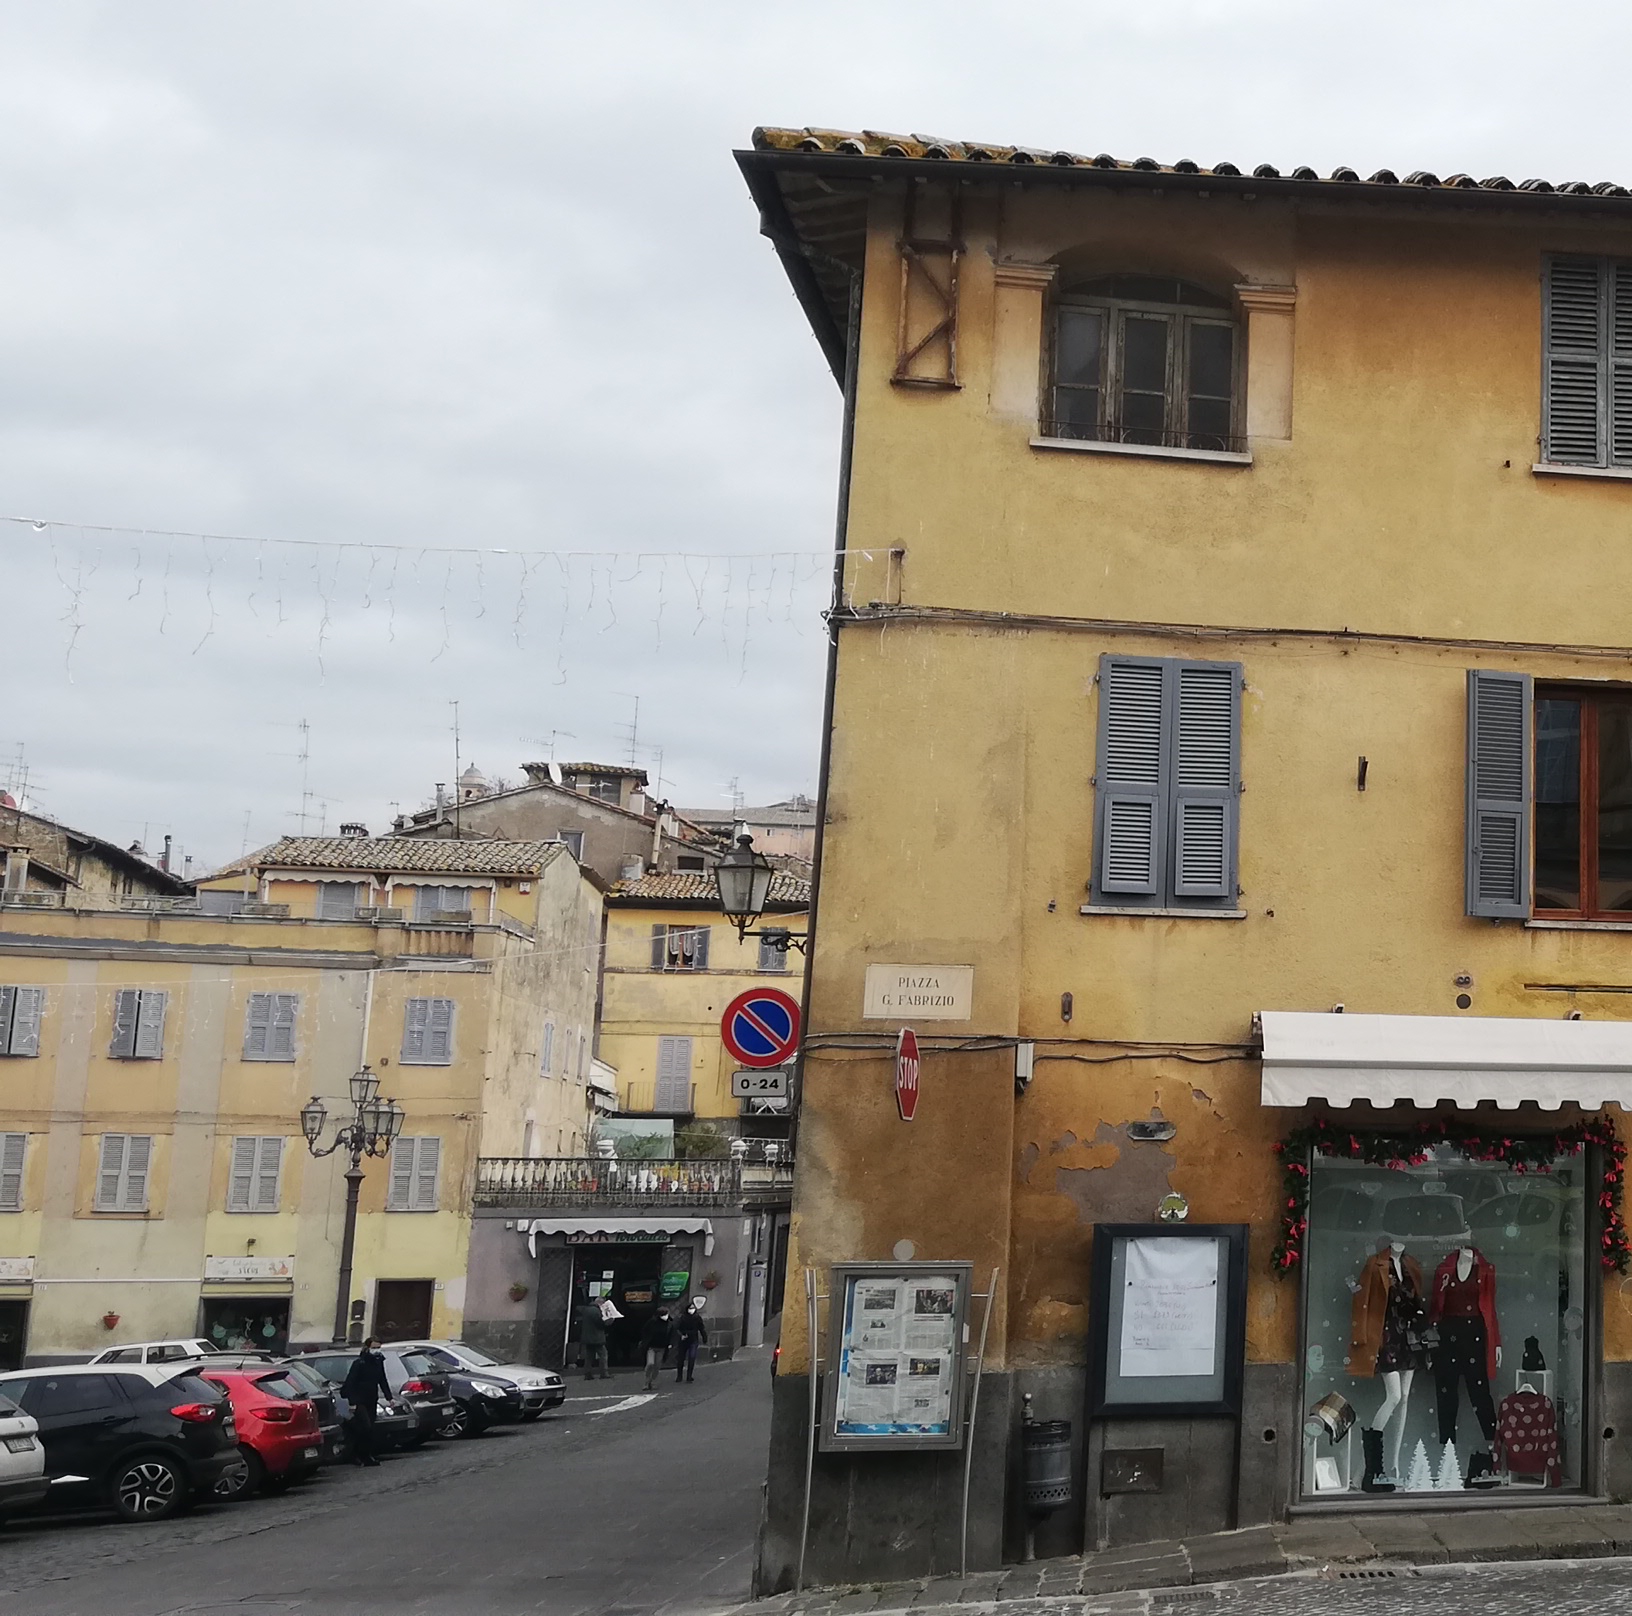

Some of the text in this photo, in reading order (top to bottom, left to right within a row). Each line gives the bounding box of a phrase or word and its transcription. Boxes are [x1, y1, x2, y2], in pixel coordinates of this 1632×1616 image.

[898, 976, 940, 989] PIAZZA
[882, 994, 955, 1007] G. FABRIZIO
[899, 1056, 918, 1091] STOP
